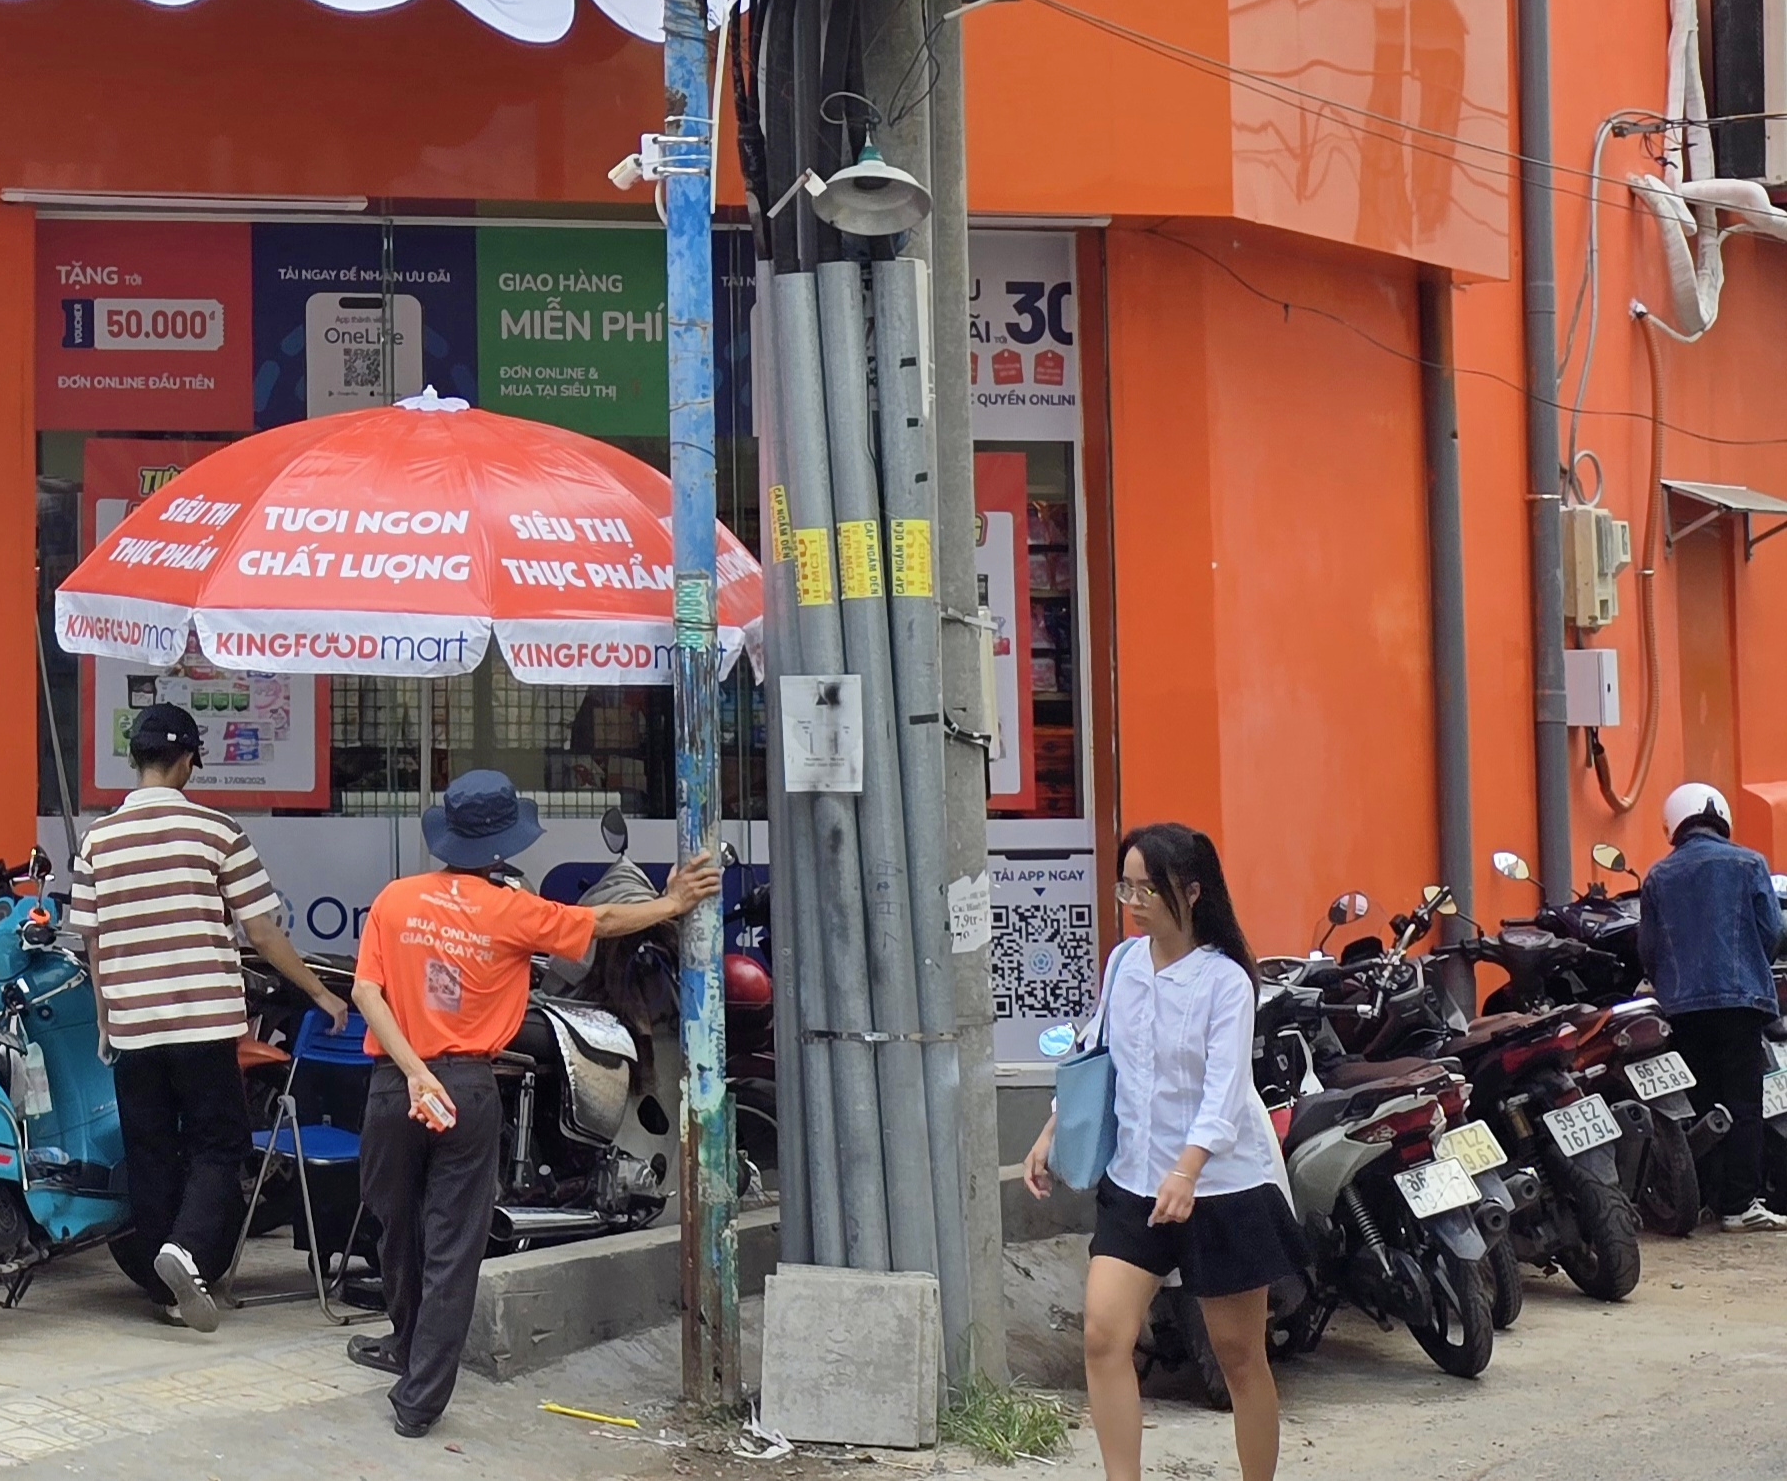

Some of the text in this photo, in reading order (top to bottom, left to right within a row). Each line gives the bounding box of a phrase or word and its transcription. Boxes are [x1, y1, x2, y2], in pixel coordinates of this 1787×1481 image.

[56, 261, 118, 289] TẶNG
[278, 266, 451, 283] TẢI NGAY ĐỂ ƯU ĐÃI
[499, 269, 622, 292] GIAO HÀNG
[500, 296, 665, 342] MIỄN PHÍ
[58, 373, 215, 389] ĐƠN ONLINE ĐẦU TIÊN
[500, 365, 598, 379] ĐƠN ONLINE &
[500, 382, 616, 401] MUA TẠI SIÊU THỊ
[977, 389, 1025, 408] QUYỀN
[159, 494, 242, 531] SIÊU THỊ
[265, 506, 469, 534] TƯƠI NGON
[509, 511, 634, 548] SIÊU THỊ
[109, 535, 218, 571] THỰC PHẨM
[238, 543, 472, 584] CHẤT LƯỢNG
[501, 558, 586, 591] THỰC
[215, 631, 468, 663] KINGFOODmart
[993, 868, 1085, 882] TẢI APP NGAY
[399, 932, 434, 947] GIAO
[406, 917, 492, 947] MUA ONLINE
[1635, 1057, 1676, 1081] 66-L1
[1639, 1071, 1691, 1097] 275.89
[1554, 1102, 1602, 1132] 59-E2
[1563, 1120, 1615, 1152] 167.94
